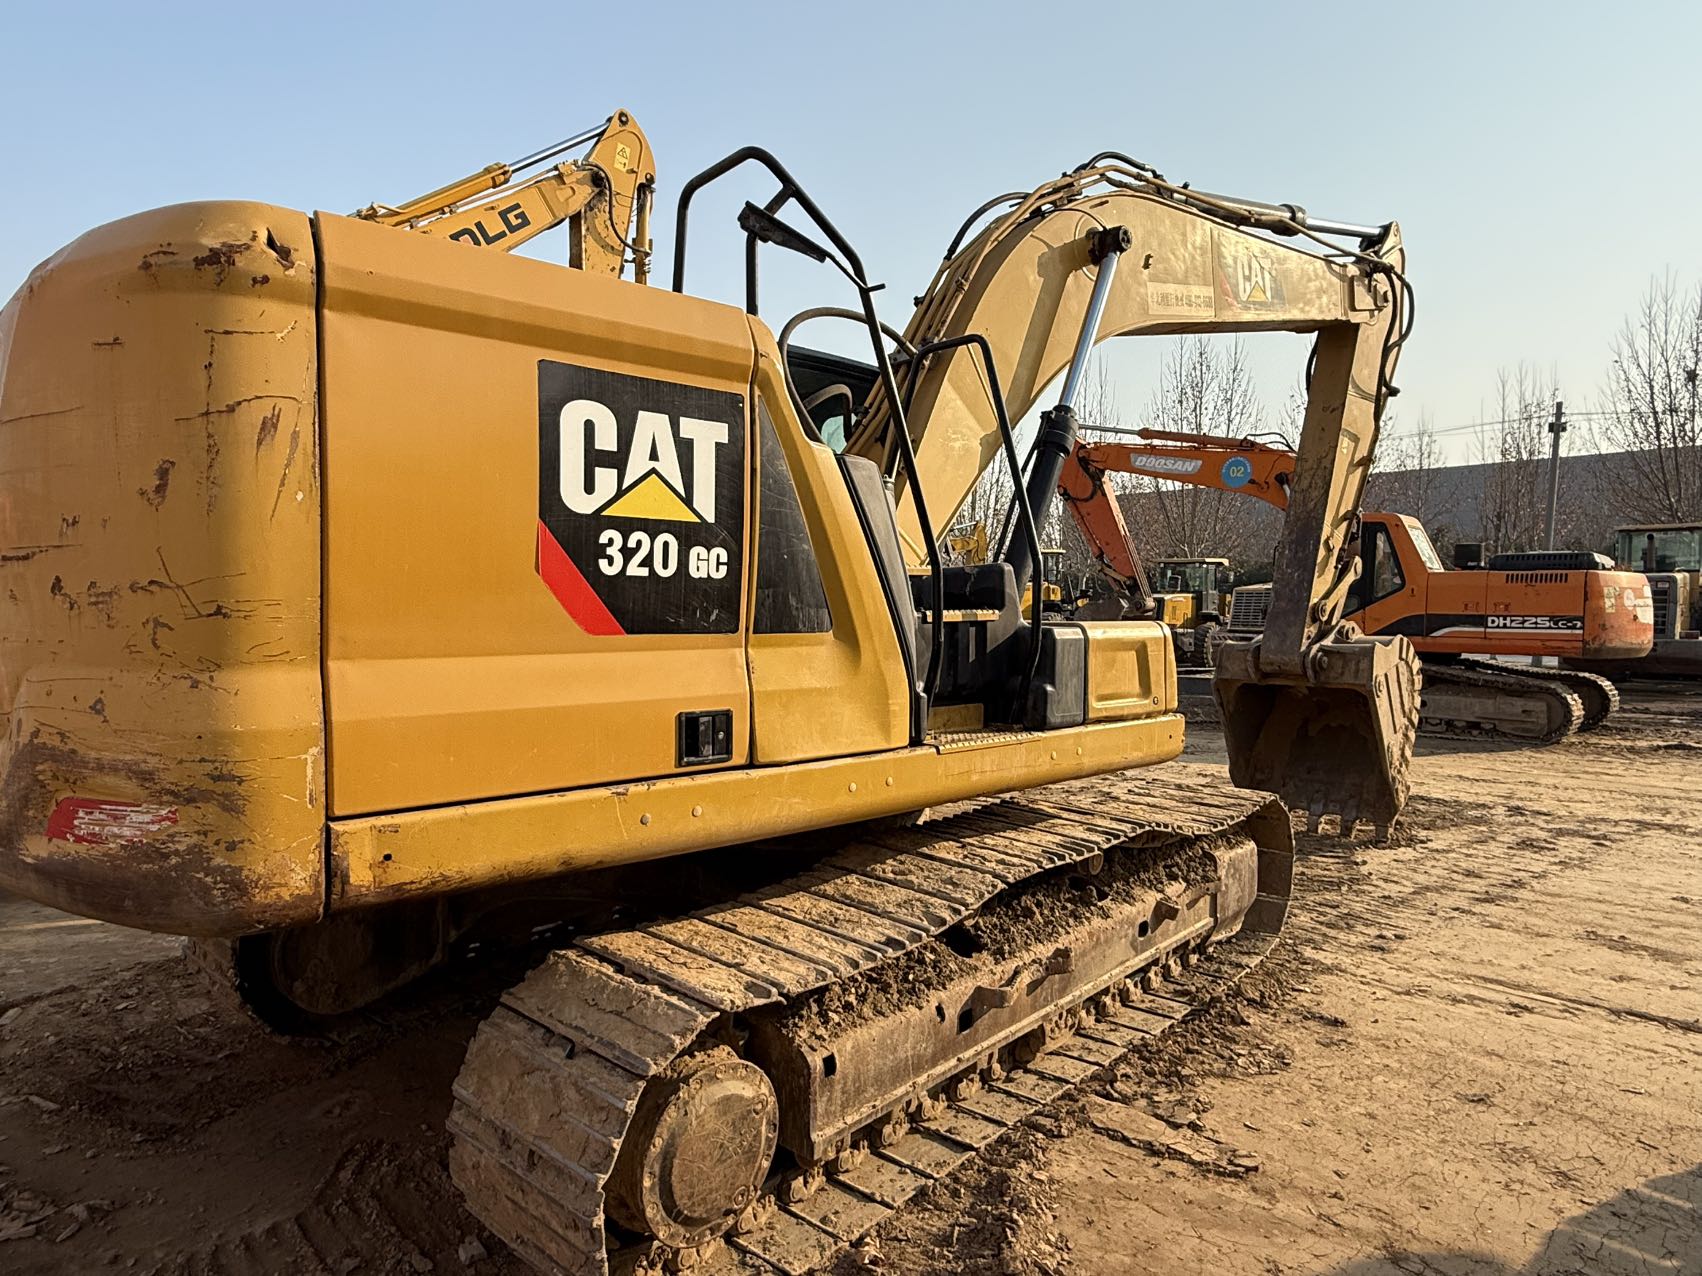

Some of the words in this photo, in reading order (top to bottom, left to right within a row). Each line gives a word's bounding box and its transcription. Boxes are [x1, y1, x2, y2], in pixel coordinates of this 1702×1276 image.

[1237, 253, 1273, 302] CAT
[560, 399, 729, 523] CAT
[1135, 456, 1195, 472] DOOSAN
[1229, 466, 1245, 477] 02
[598, 529, 678, 577] 320
[688, 545, 728, 579] GC
